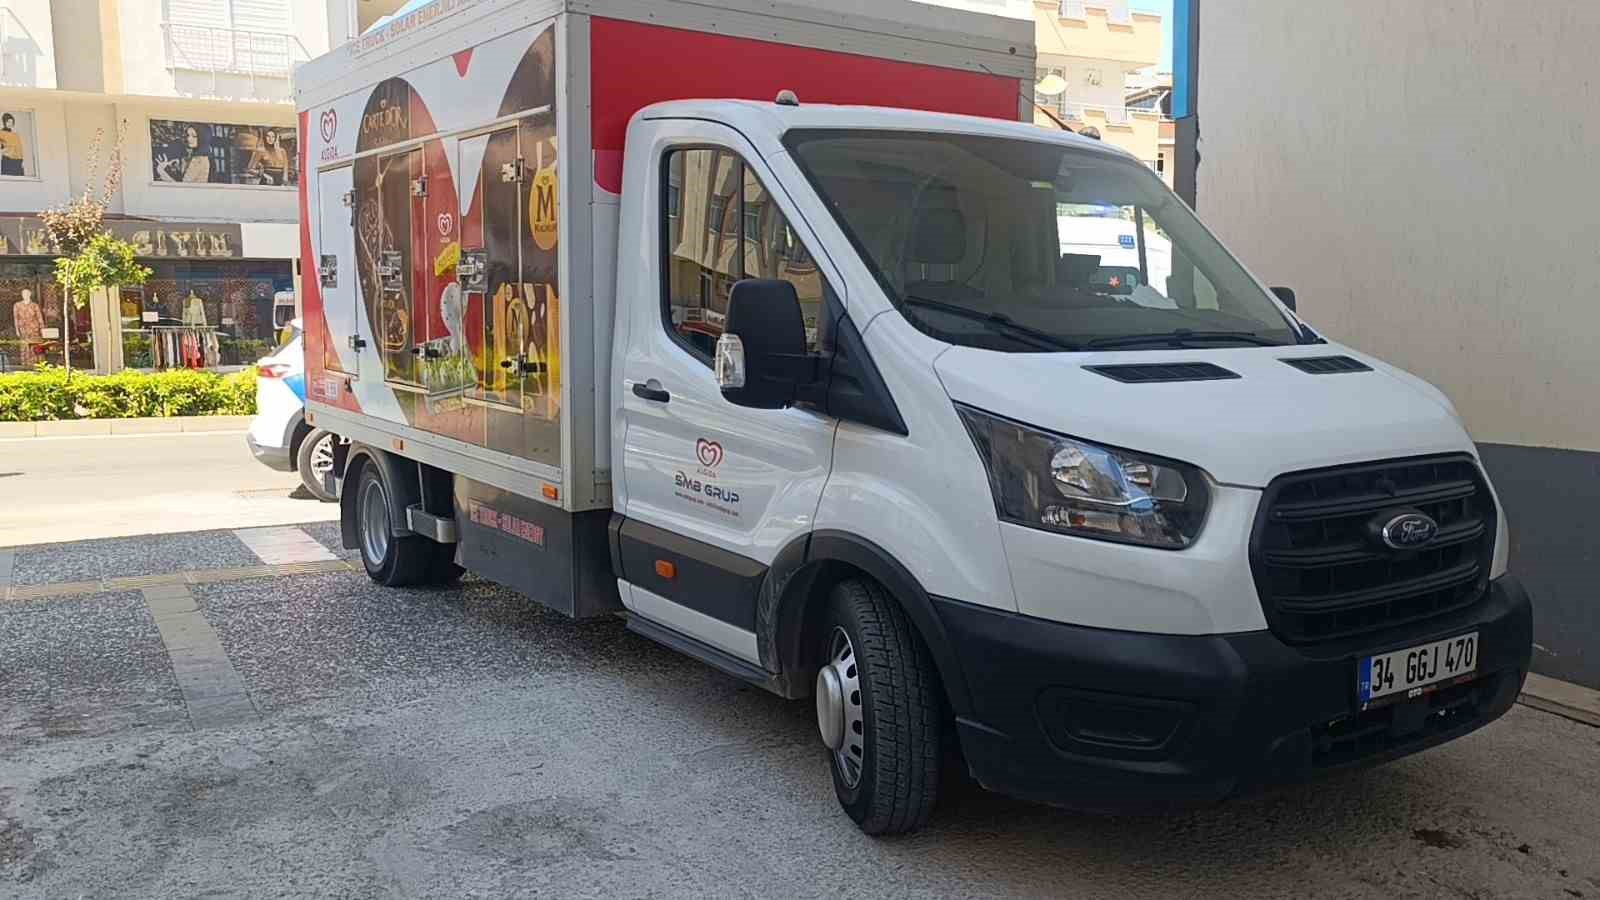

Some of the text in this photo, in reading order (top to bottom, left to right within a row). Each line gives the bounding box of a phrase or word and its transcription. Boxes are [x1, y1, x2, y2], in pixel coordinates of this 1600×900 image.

[535, 183, 555, 222] M
[704, 484, 740, 504] GRUP
[1400, 520, 1430, 543] Ford
[1371, 657, 1395, 692] 34
[1405, 645, 1438, 684] GGJ
[1444, 637, 1474, 672] 470
